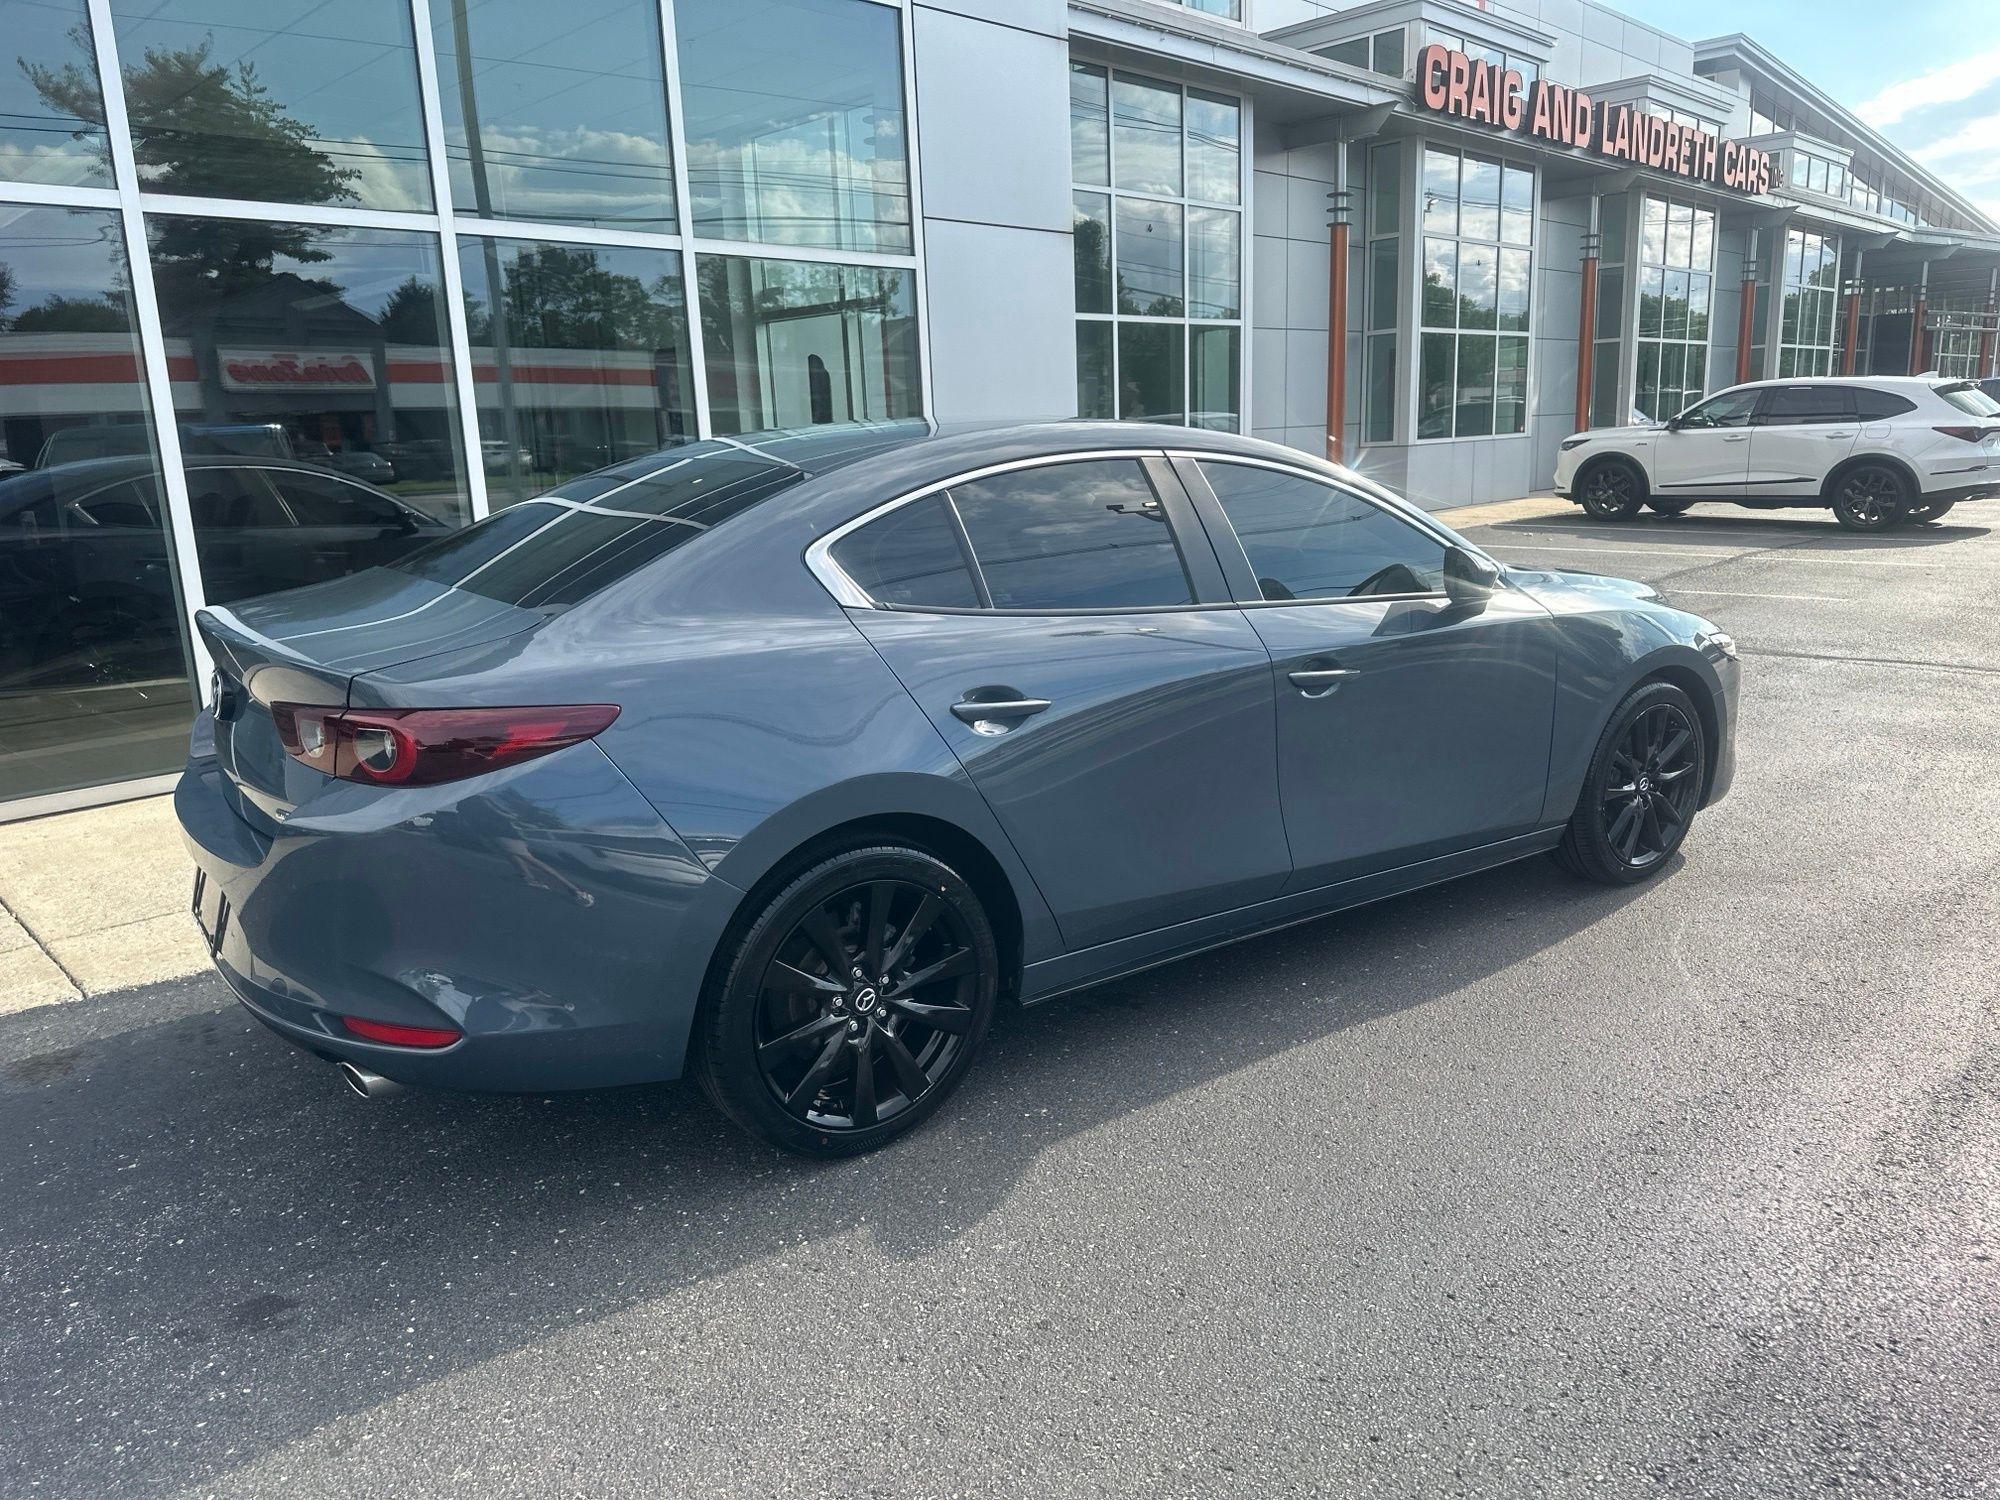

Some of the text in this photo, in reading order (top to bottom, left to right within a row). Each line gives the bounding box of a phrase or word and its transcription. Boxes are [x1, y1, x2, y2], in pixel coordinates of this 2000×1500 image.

[1421, 44, 1523, 131] CRAIG
[1530, 79, 1592, 149] AND
[1600, 101, 1718, 182] LANDRETH
[1723, 139, 1770, 195] CARS
